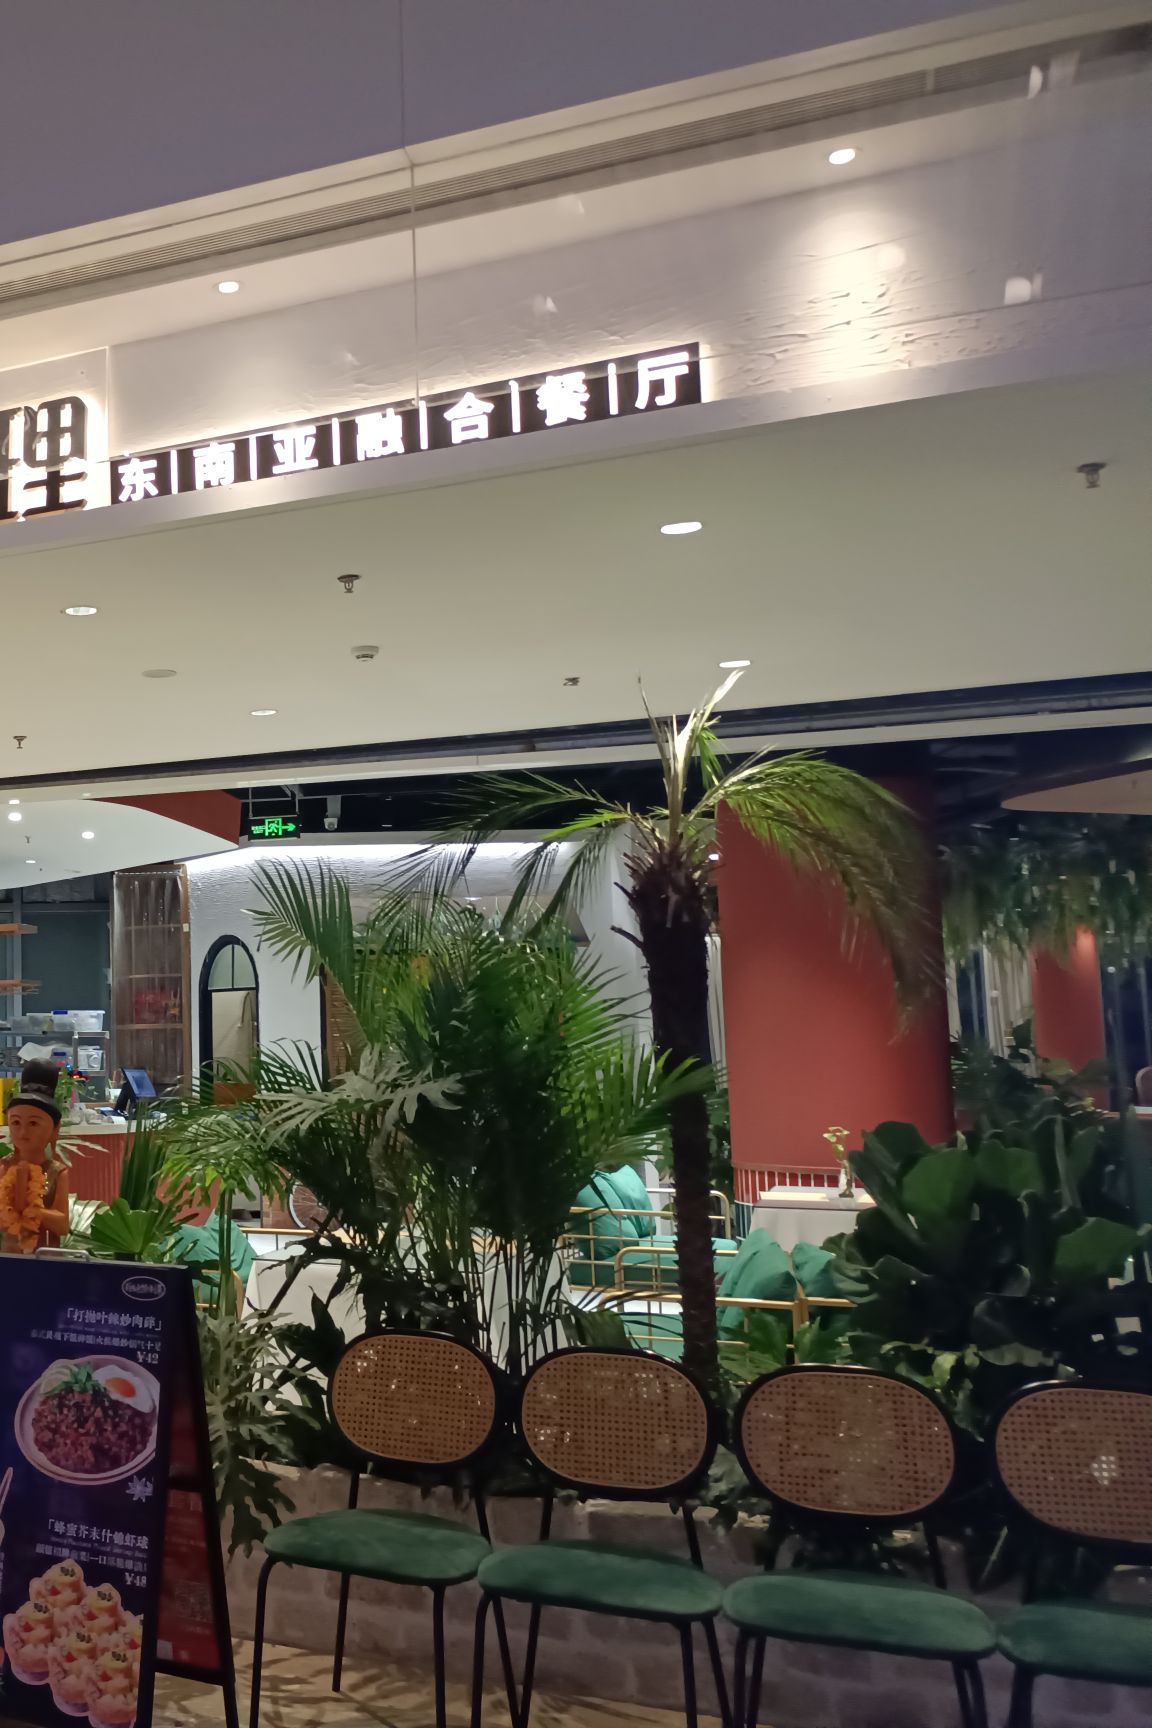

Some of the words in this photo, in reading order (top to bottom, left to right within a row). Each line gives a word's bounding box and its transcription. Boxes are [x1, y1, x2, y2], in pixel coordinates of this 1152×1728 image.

[119, 351, 690, 502] 东南亚融合餐厅
